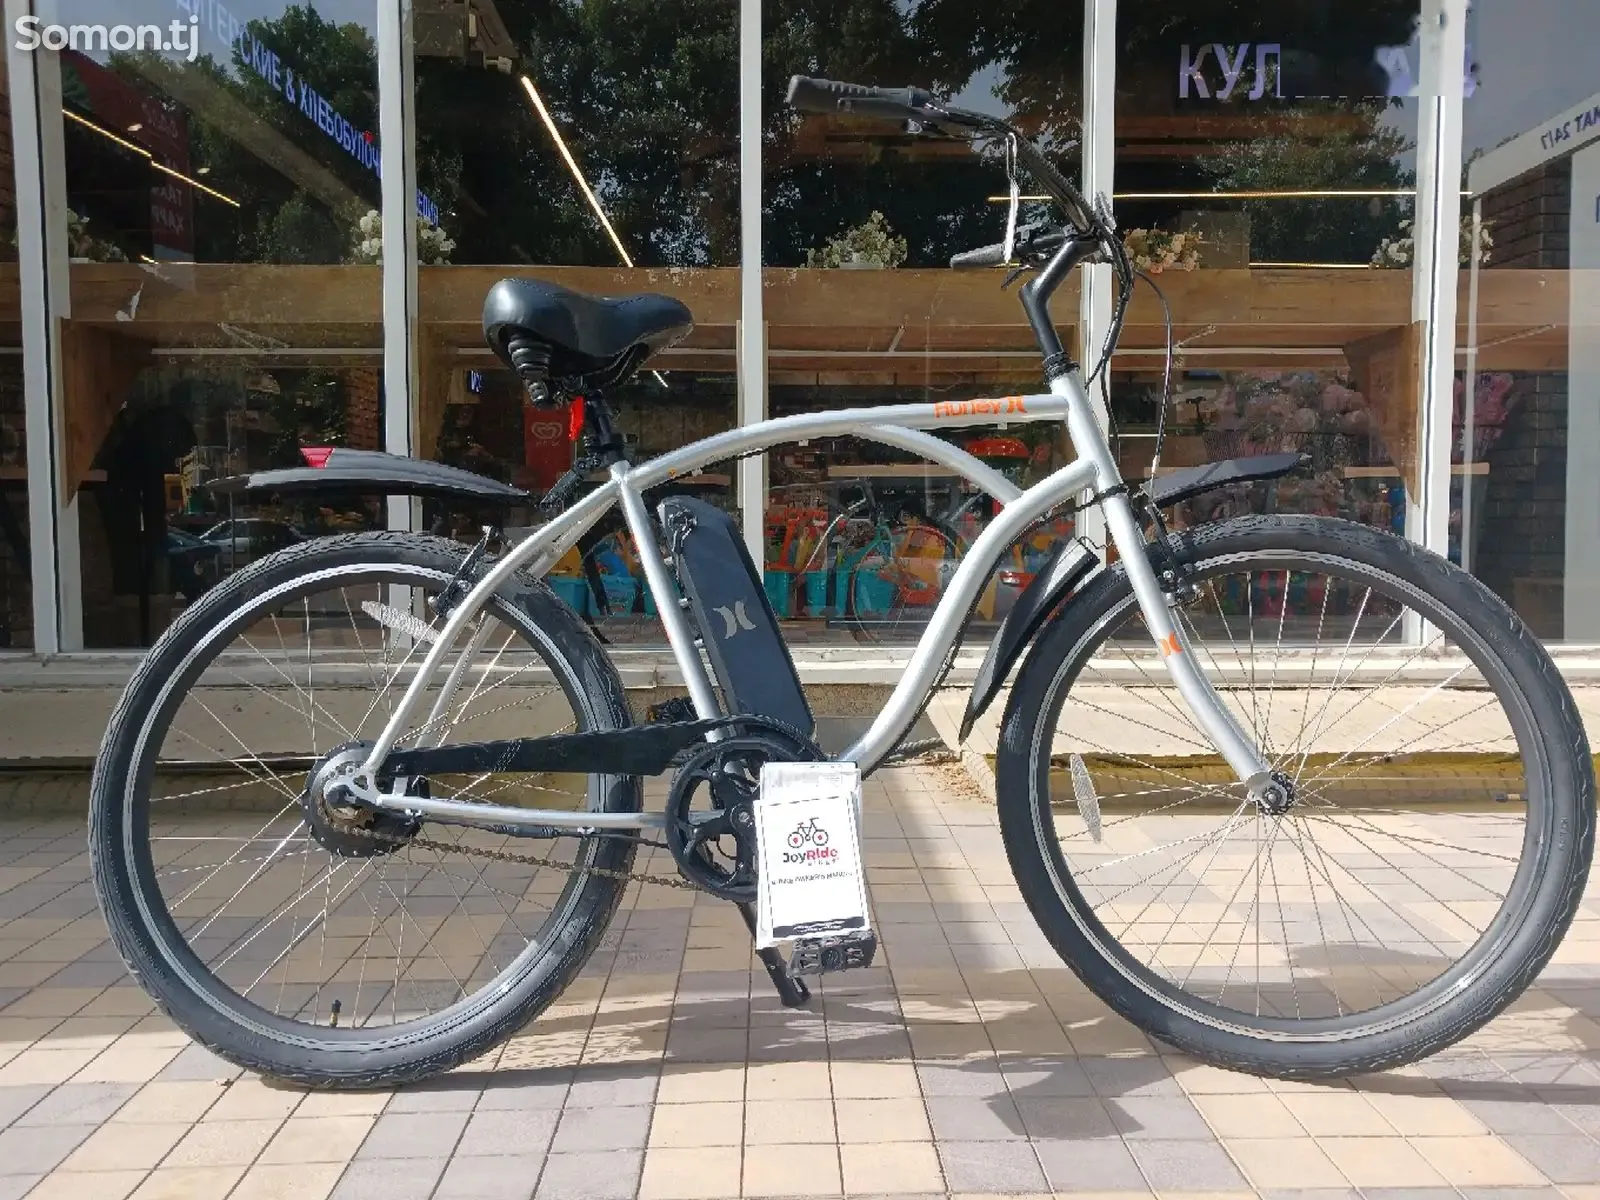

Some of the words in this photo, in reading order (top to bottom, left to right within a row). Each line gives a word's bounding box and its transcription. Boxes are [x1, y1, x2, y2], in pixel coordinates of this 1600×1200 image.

[177, 0, 282, 91] ИТЕРСКИЕ
[286, 67, 296, 105] &
[299, 78, 381, 178] ХЛЕБОБУЛОЧ
[934, 399, 1002, 418] Hurley
